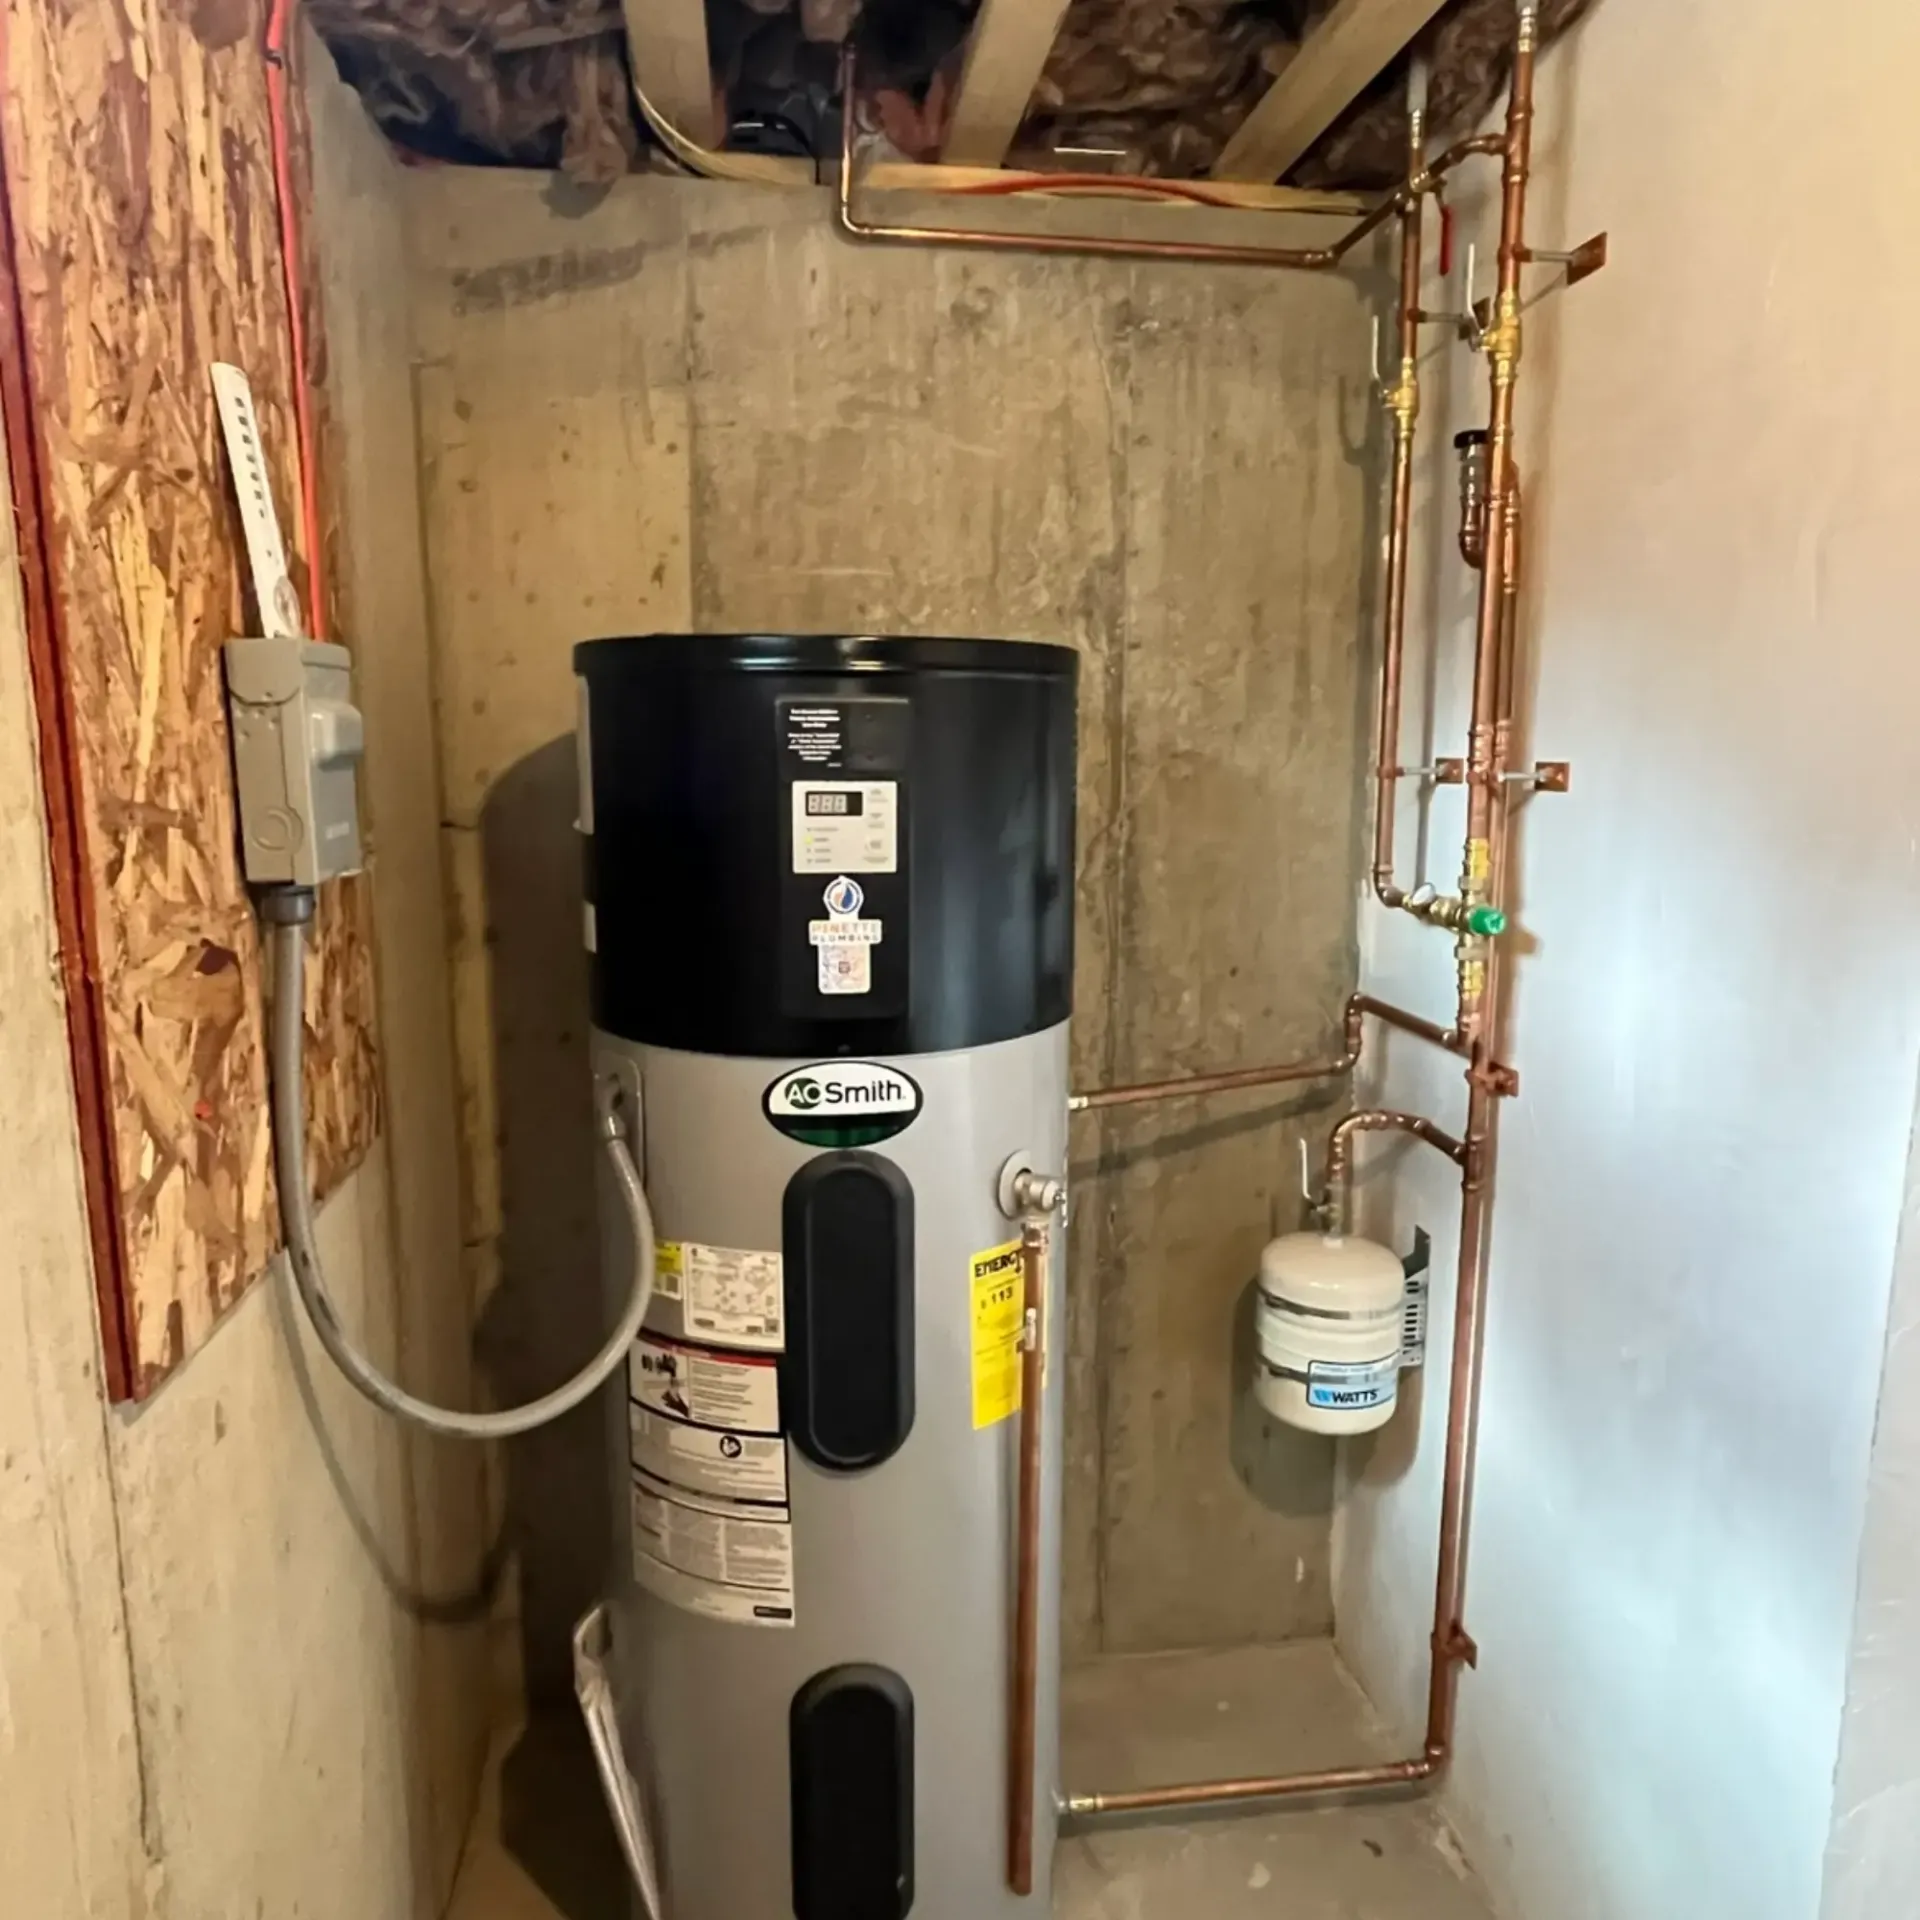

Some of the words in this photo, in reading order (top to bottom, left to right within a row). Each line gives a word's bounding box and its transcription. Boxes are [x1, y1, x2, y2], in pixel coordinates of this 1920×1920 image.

[825, 1080, 902, 1104] Smith
[974, 1248, 1023, 1277] ENERG
[1332, 1388, 1379, 1403] WATTS
